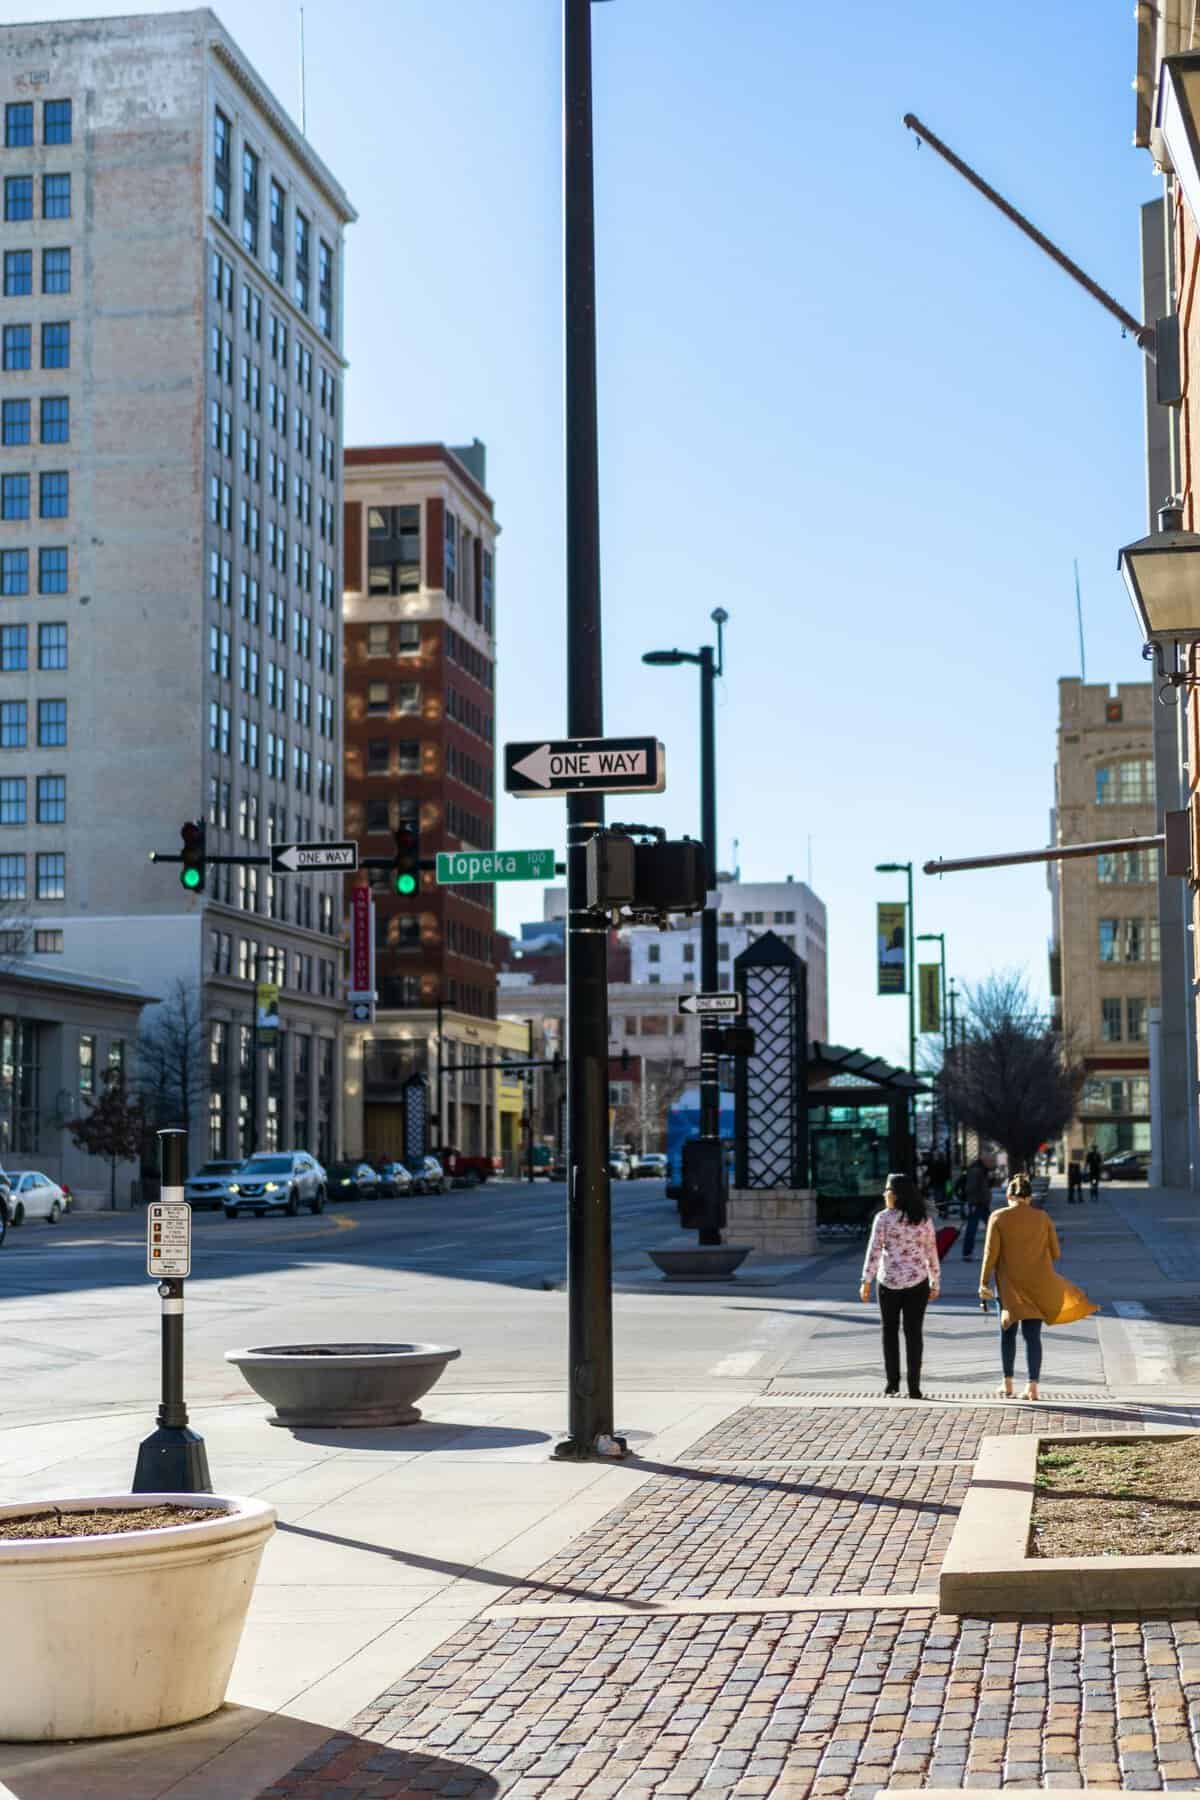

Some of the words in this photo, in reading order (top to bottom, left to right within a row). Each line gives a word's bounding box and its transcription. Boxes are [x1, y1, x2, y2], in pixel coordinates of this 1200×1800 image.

[550, 755, 591, 775] ONE
[598, 753, 640, 773] WAY
[298, 852, 320, 864] ONE
[326, 851, 349, 863] WAY
[527, 852, 546, 864] 100
[447, 854, 516, 880] Topeka
[533, 866, 540, 877] N
[715, 998, 731, 1007] WAY
